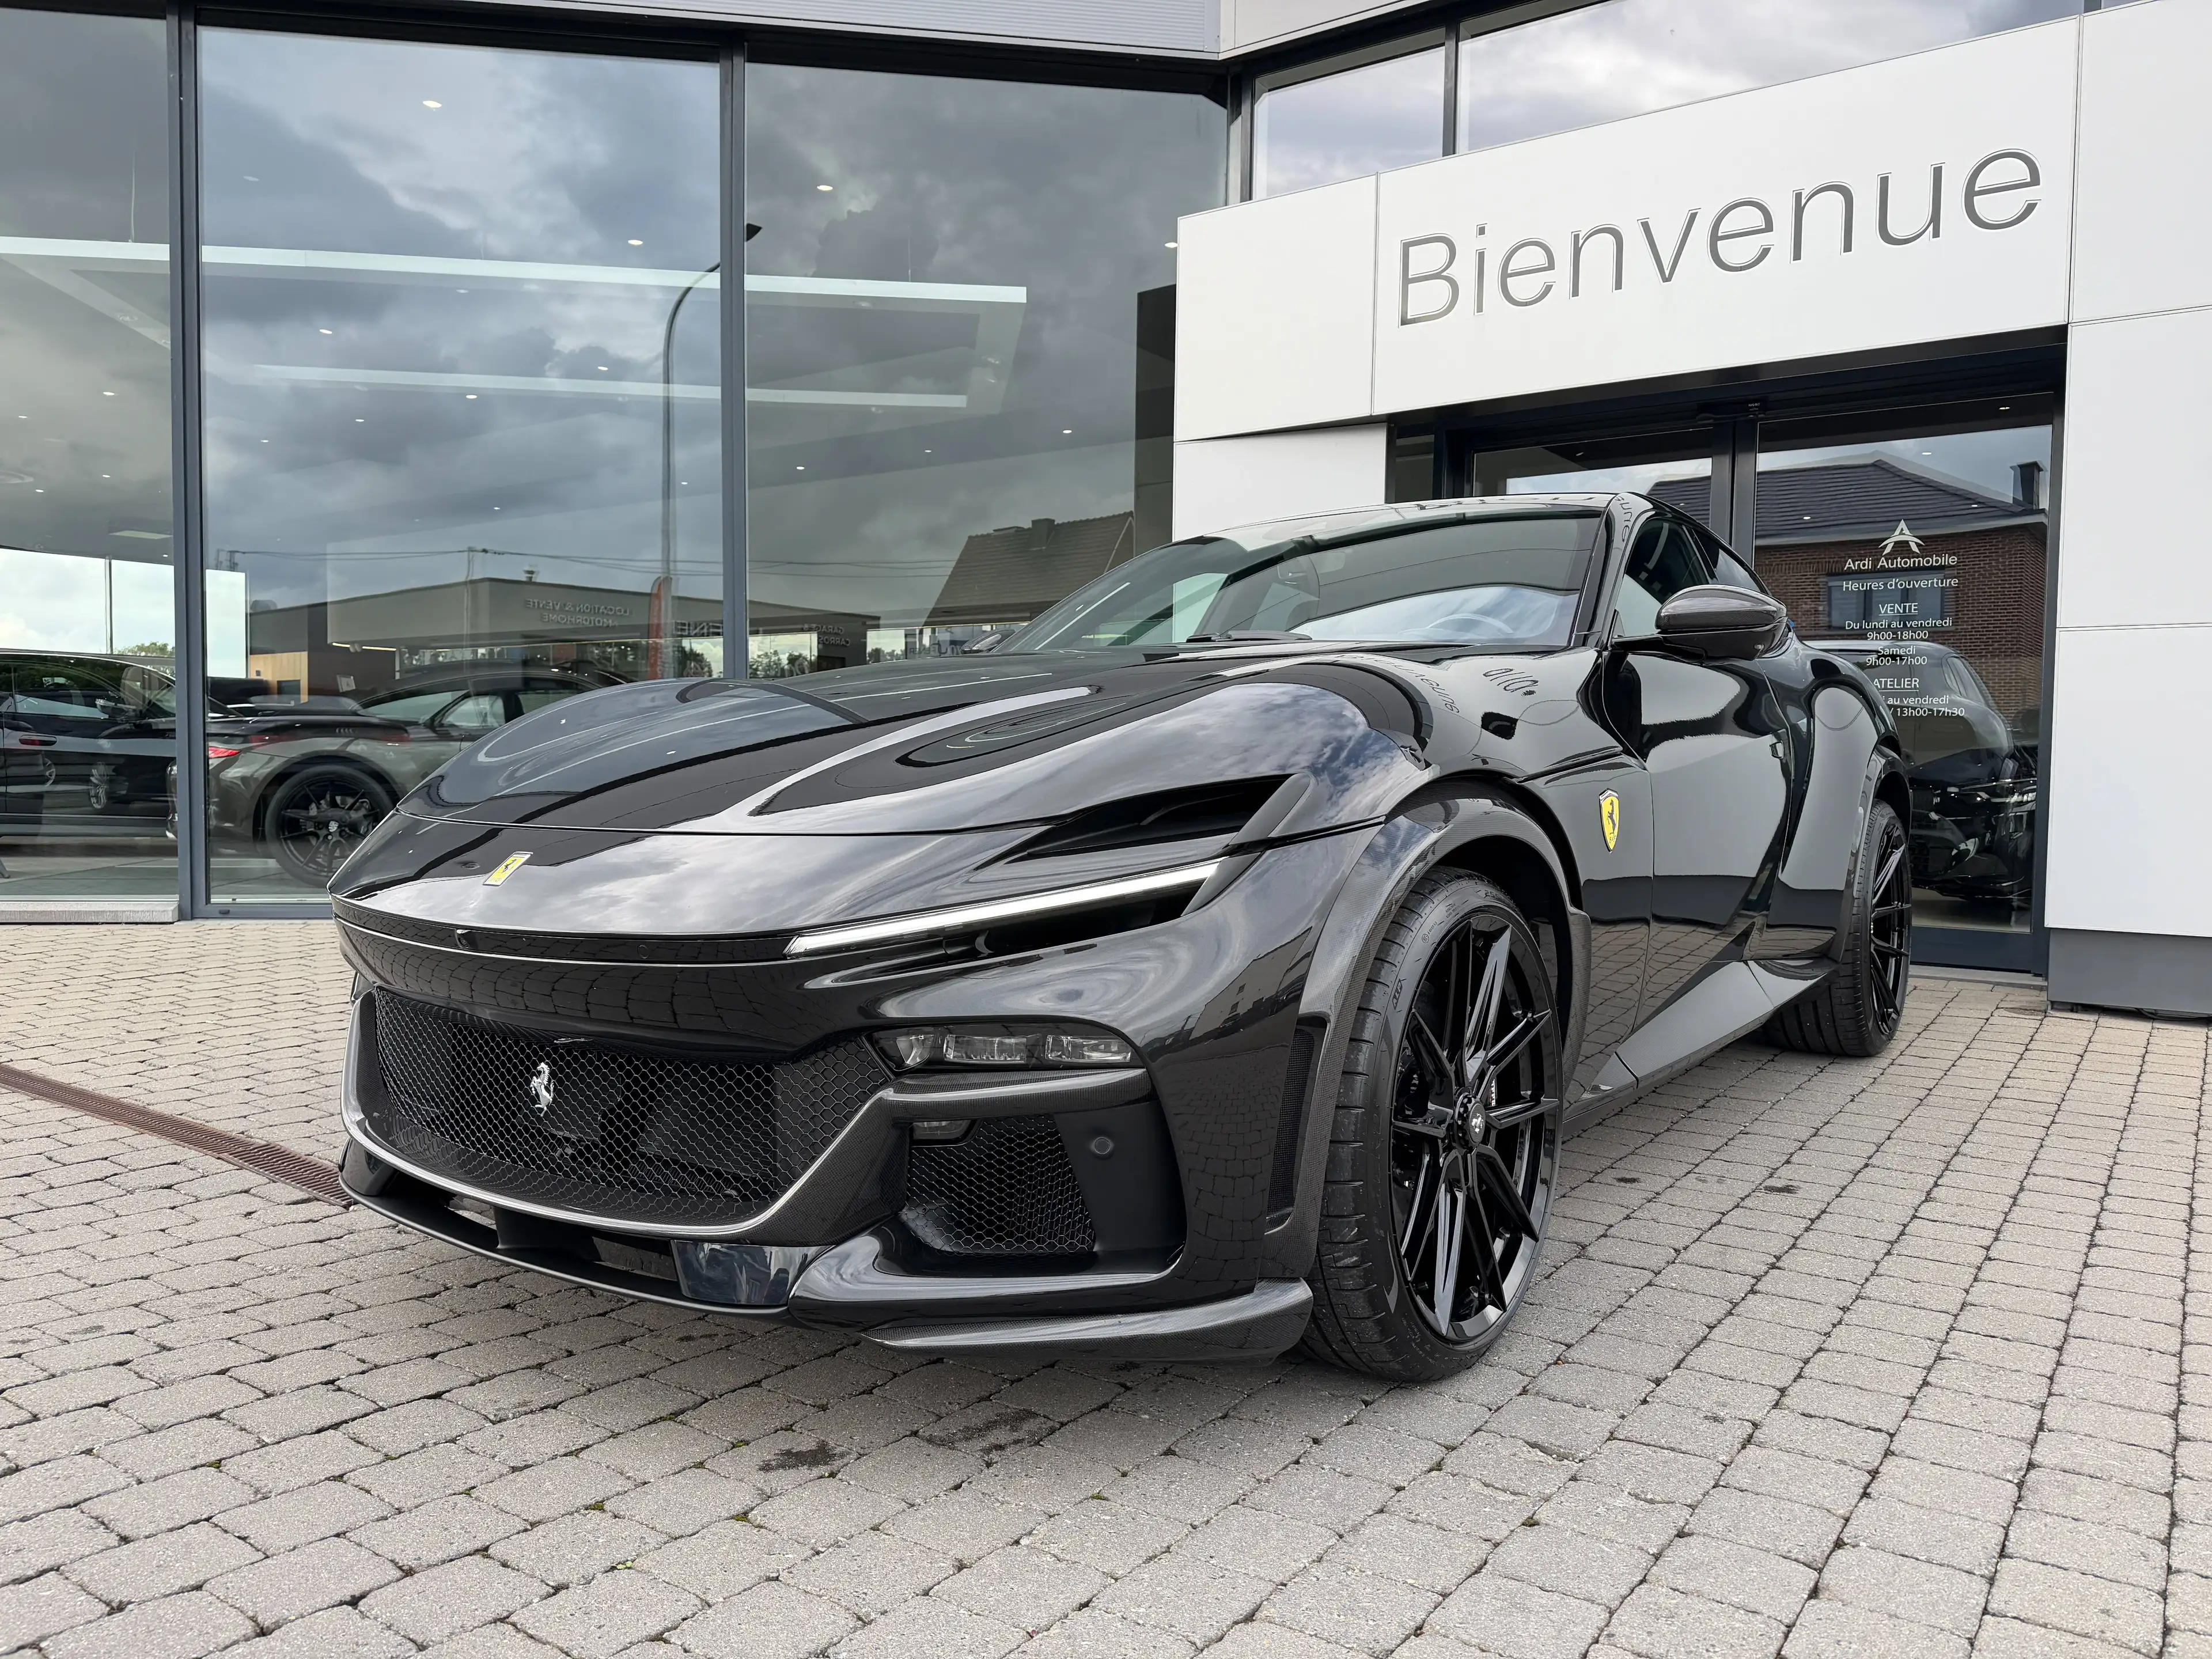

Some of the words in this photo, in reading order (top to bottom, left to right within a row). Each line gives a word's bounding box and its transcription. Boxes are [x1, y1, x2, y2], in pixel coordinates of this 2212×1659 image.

[1397, 148, 2043, 328] Bienvenue
[1844, 558, 1872, 570] Ardi
[1877, 554, 1957, 569] Automobile
[1843, 581, 1884, 591] Heures
[1887, 578, 1959, 590] d'ouverture
[1879, 603, 1918, 614] VENTE
[1846, 621, 1859, 630] Du
[1862, 619, 1888, 629] lundi
[1906, 618, 1952, 627] vendredi
[1867, 631, 1929, 641] 9h00-18h00
[1878, 646, 1916, 655] Samedi
[1866, 656, 1927, 666] 9h00-17h00
[1873, 678, 1919, 688] ATELIER
[1903, 695, 1949, 704] vendredi
[1896, 707, 1965, 717] 13h00-17h30
